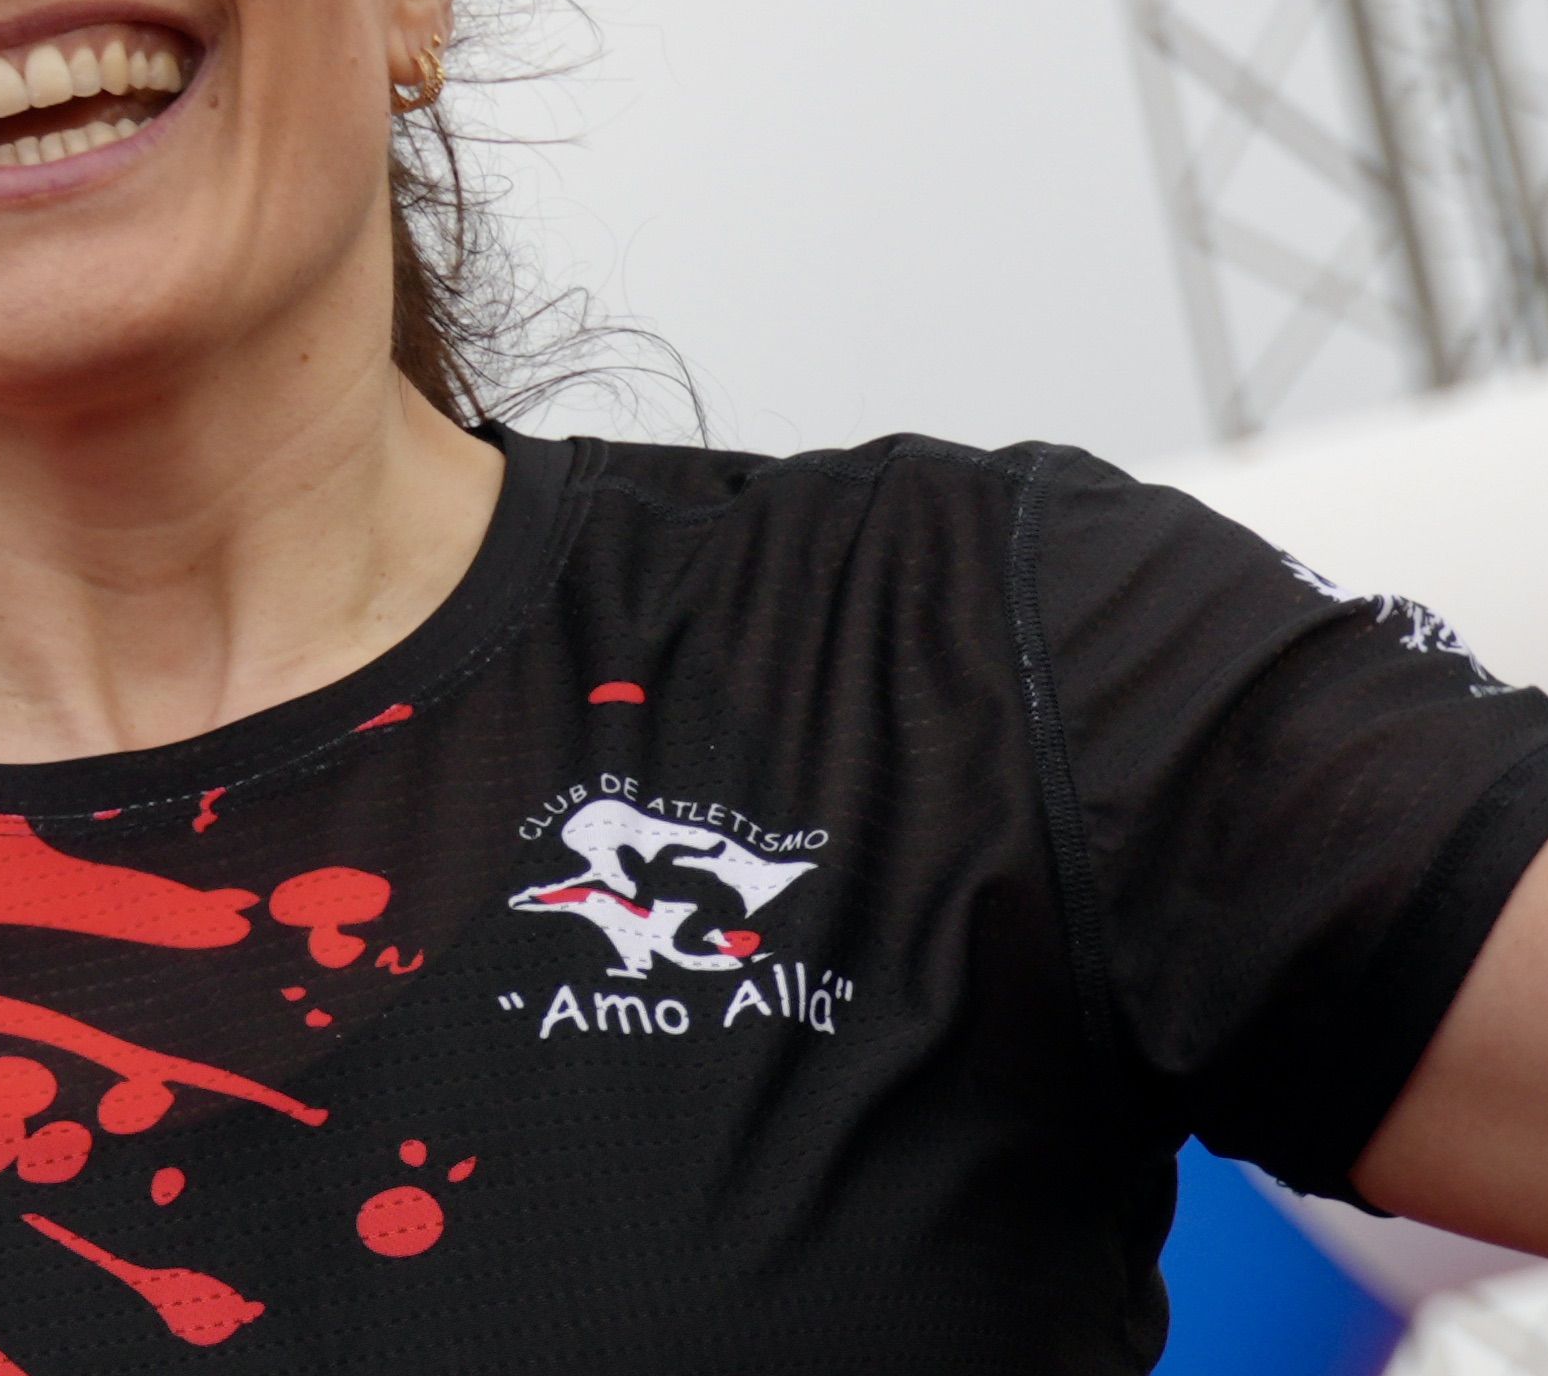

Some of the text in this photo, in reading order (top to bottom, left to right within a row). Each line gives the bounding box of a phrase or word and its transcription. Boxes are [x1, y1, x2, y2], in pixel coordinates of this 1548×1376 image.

[519, 773, 828, 852] CLUB DE ATLETISMO
[498, 985, 689, 1038] "Amo
